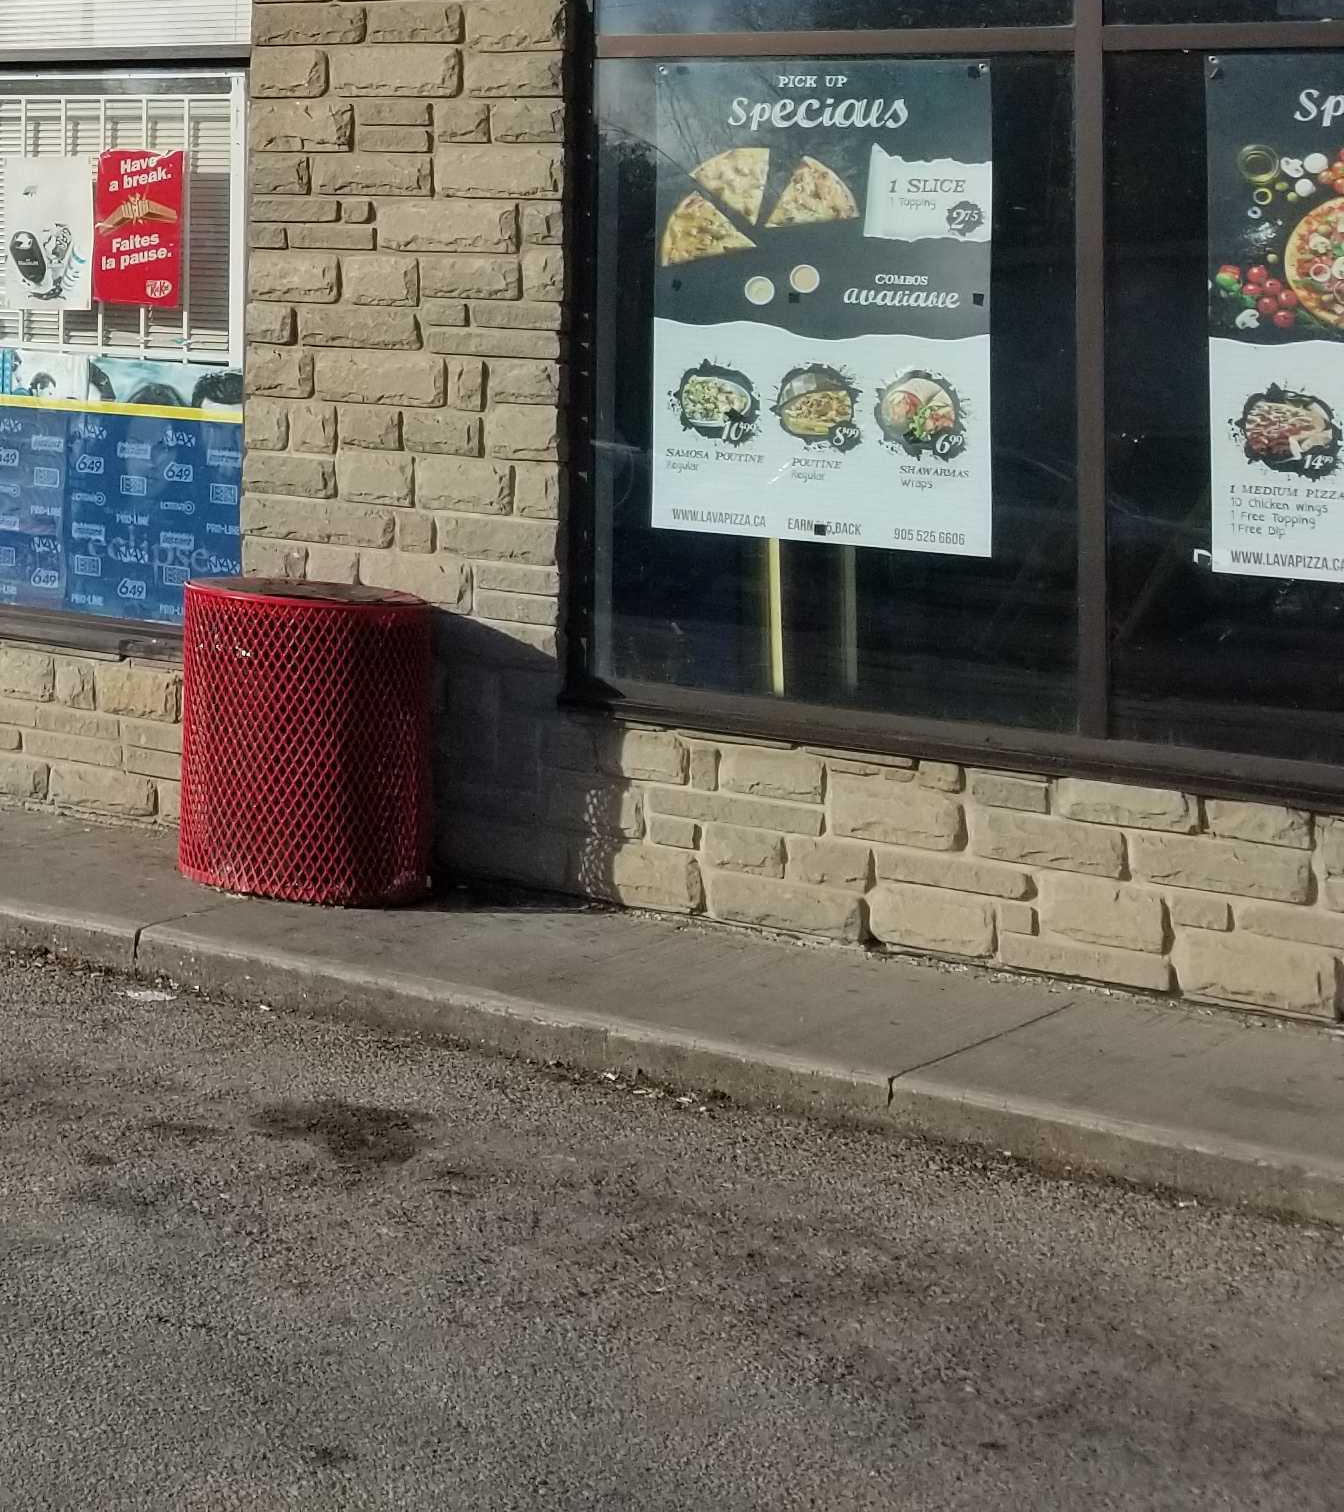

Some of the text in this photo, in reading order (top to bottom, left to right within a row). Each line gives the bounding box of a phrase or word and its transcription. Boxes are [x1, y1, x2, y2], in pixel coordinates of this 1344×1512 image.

[778, 75, 848, 88] PICK UP
[728, 96, 909, 131] Specials
[120, 156, 158, 175] Have
[108, 167, 172, 192] a break.
[889, 178, 965, 193] 1 SLICE
[112, 233, 160, 253] Faites
[101, 247, 172, 271] la pause.
[874, 273, 929, 286] COMBOS
[76, 454, 104, 474] 649
[666, 448, 765, 464] SAMOSA POUTINE
[791, 457, 843, 469] POUTINE
[164, 461, 194, 482] 649
[899, 465, 969, 478] SHAWARMAS
[1242, 484, 1298, 497] MEDIUM
[671, 507, 767, 528] WWW.LAVAPIZZA.CA
[1295, 503, 1329, 517] wings
[788, 517, 813, 532] EARN
[835, 522, 862, 536] BACK
[1238, 523, 1263, 535] Free
[1240, 511, 1265, 523] Free
[1272, 512, 1316, 530] Topping
[894, 527, 966, 546] 905 525 6606
[31, 567, 59, 588] 649
[117, 577, 147, 600] 649
